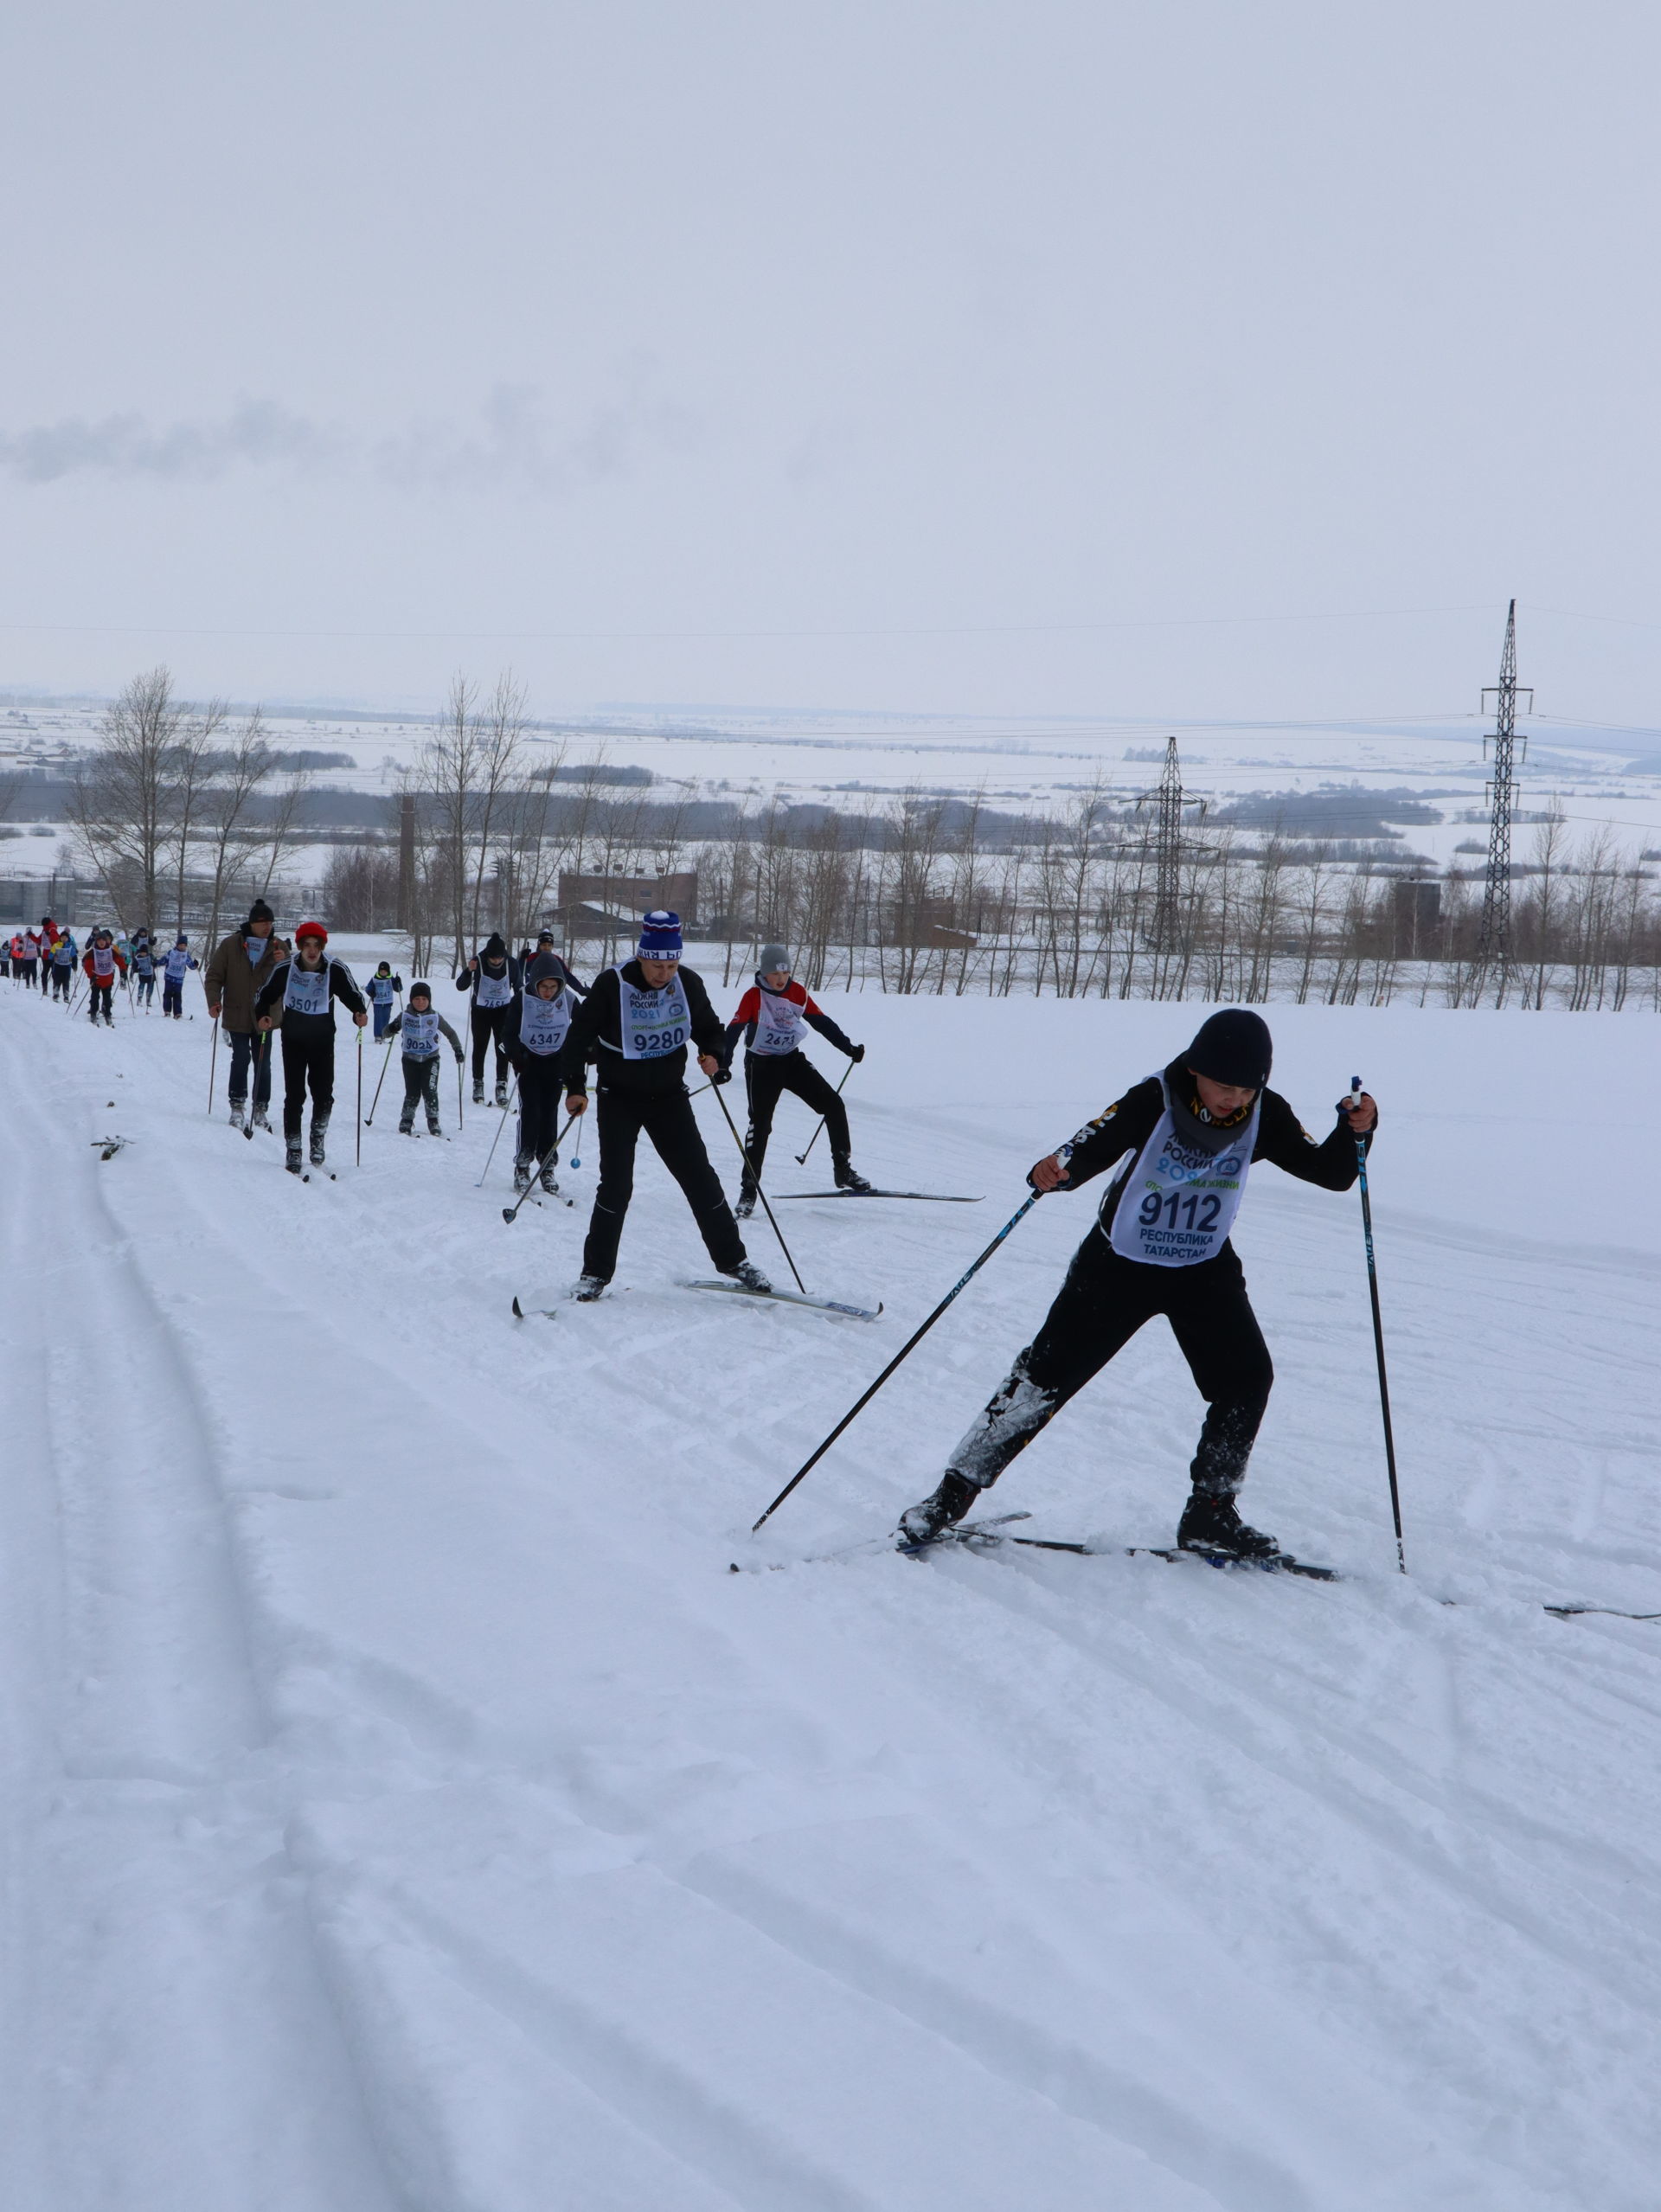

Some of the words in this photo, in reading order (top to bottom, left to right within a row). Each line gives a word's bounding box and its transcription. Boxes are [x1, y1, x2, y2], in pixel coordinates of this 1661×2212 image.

[289, 996, 318, 1012] 3501
[630, 1000, 659, 1010] РОССИИ
[632, 1009, 660, 1019] 2021
[406, 1037, 433, 1049] 9024
[529, 1032, 561, 1045] 6347
[634, 1027, 684, 1051] 9280
[1163, 1141, 1214, 1170] РОССИИ
[1138, 1191, 1222, 1233] 9112
[1139, 1228, 1214, 1246] РЕСПУБЛИКА
[1144, 1243, 1207, 1260] ТАТАРСТАН
